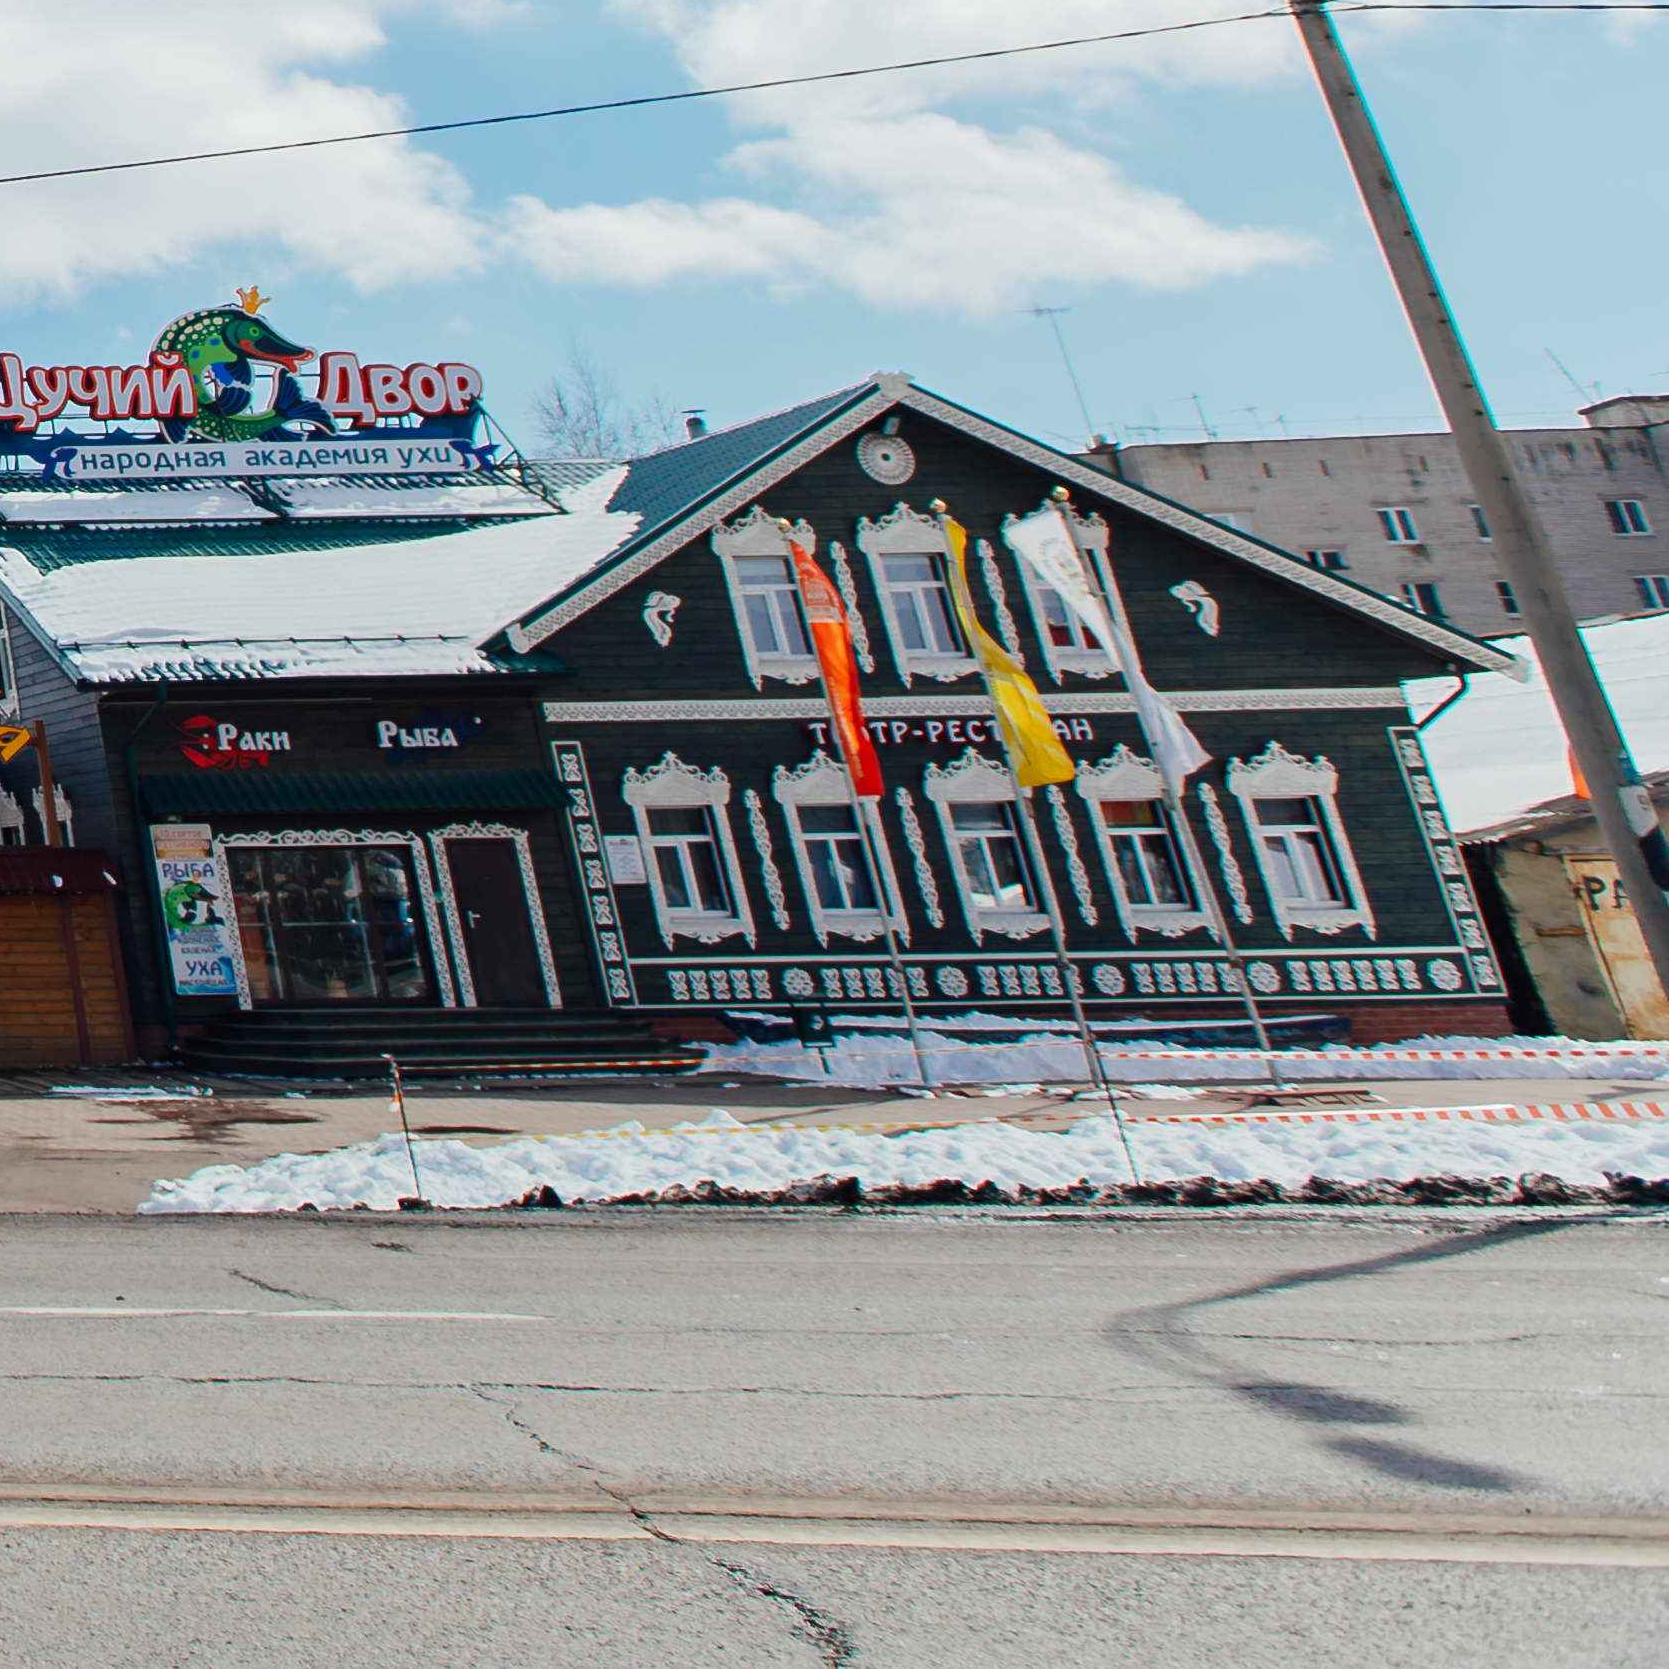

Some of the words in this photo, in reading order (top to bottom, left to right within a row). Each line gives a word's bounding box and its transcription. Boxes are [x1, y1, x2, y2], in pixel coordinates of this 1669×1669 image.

[316, 350, 483, 428] Двор
[80, 447, 225, 474] народная
[245, 446, 389, 470] академия
[397, 445, 453, 468] ухи
[162, 862, 215, 878] РЫБА
[185, 960, 223, 977] УХА
